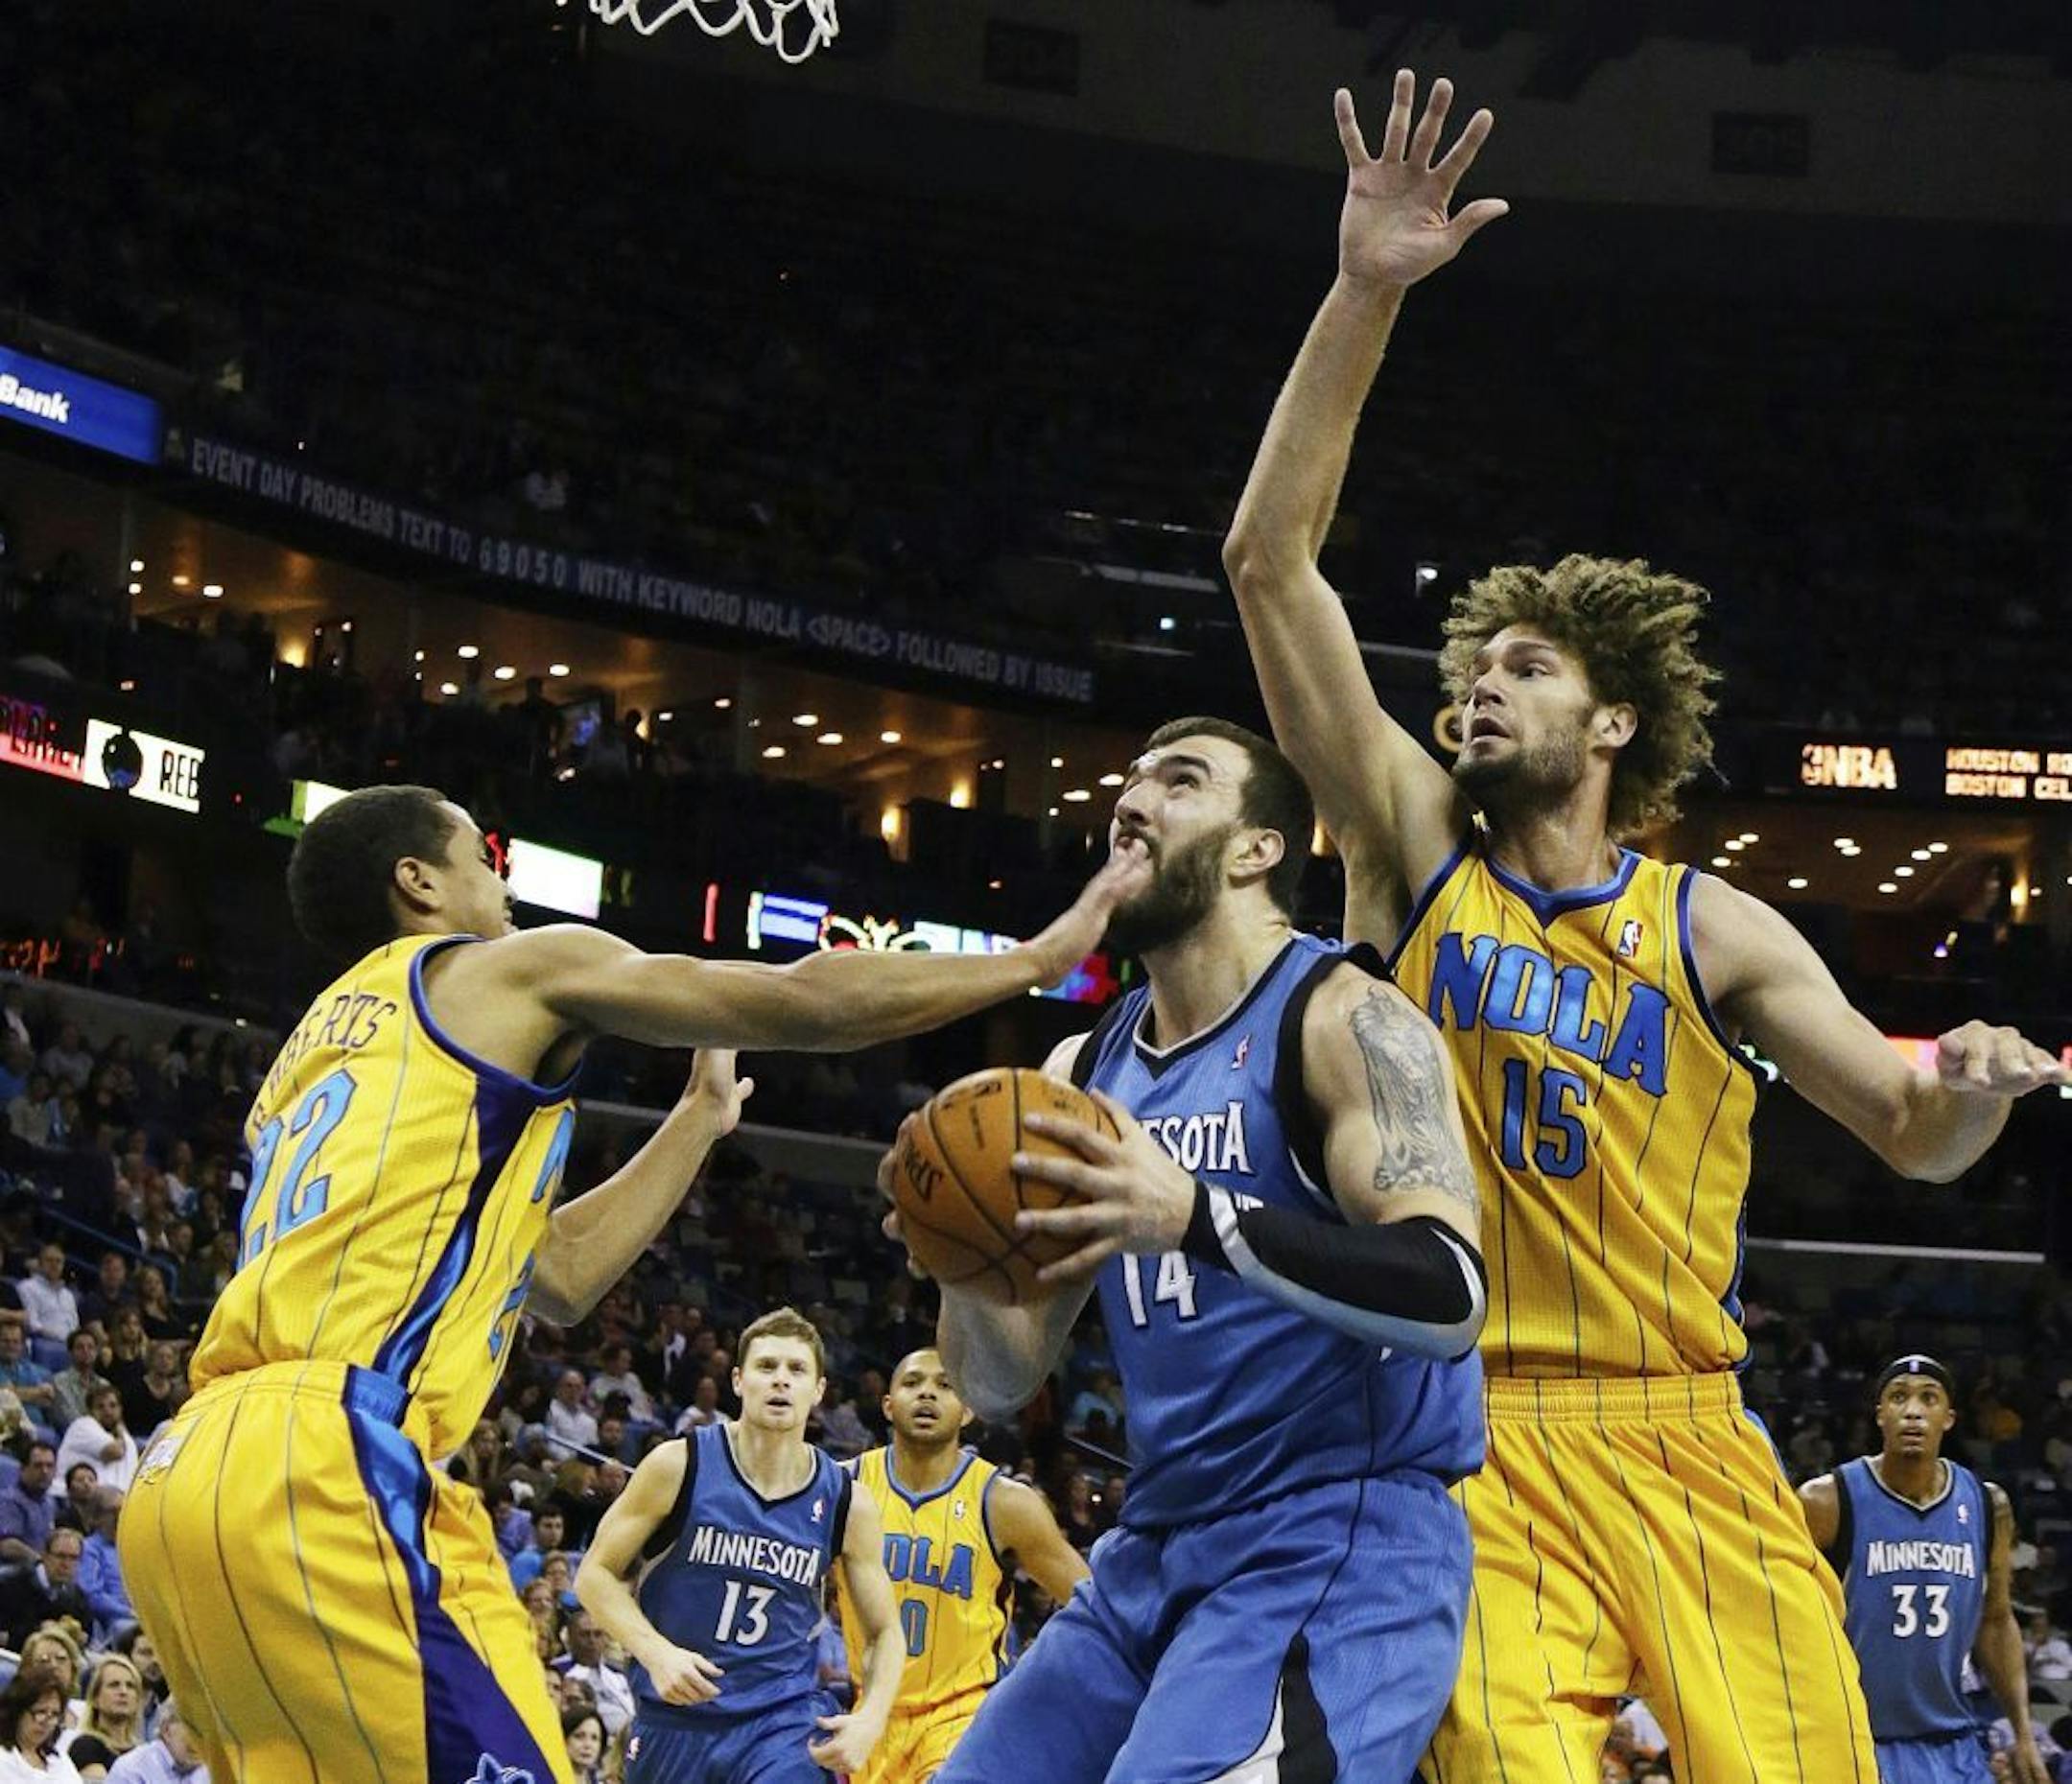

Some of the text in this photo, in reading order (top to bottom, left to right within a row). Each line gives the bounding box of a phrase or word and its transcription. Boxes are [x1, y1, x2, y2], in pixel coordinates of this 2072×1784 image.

[0, 373, 70, 424] Bank
[192, 437, 256, 491] EVENT
[259, 462, 296, 504] DAY
[300, 475, 394, 538] PROBLEMS
[399, 509, 445, 553] TEXT
[448, 526, 472, 564] TO
[578, 559, 632, 602] WITH
[638, 574, 742, 625] KEYWORD
[745, 598, 801, 641] NOLA
[895, 629, 999, 683] FOLLOWED
[1003, 654, 1031, 688] BY
[1035, 662, 1093, 702] ISSUE
[1822, 745, 1897, 789] NBA
[1945, 773, 2026, 799] BOSTON
[1946, 748, 2039, 774] HOUSTON
[1428, 932, 1670, 1097] NOLA
[1499, 1058, 1587, 1178] 15
[1122, 1250, 1197, 1326] 14
[688, 1525, 821, 1587] MINNESOTA
[1867, 1540, 1976, 1579] MINNESOTA
[715, 1580, 778, 1646] 13
[1893, 1584, 1950, 1638] 33
